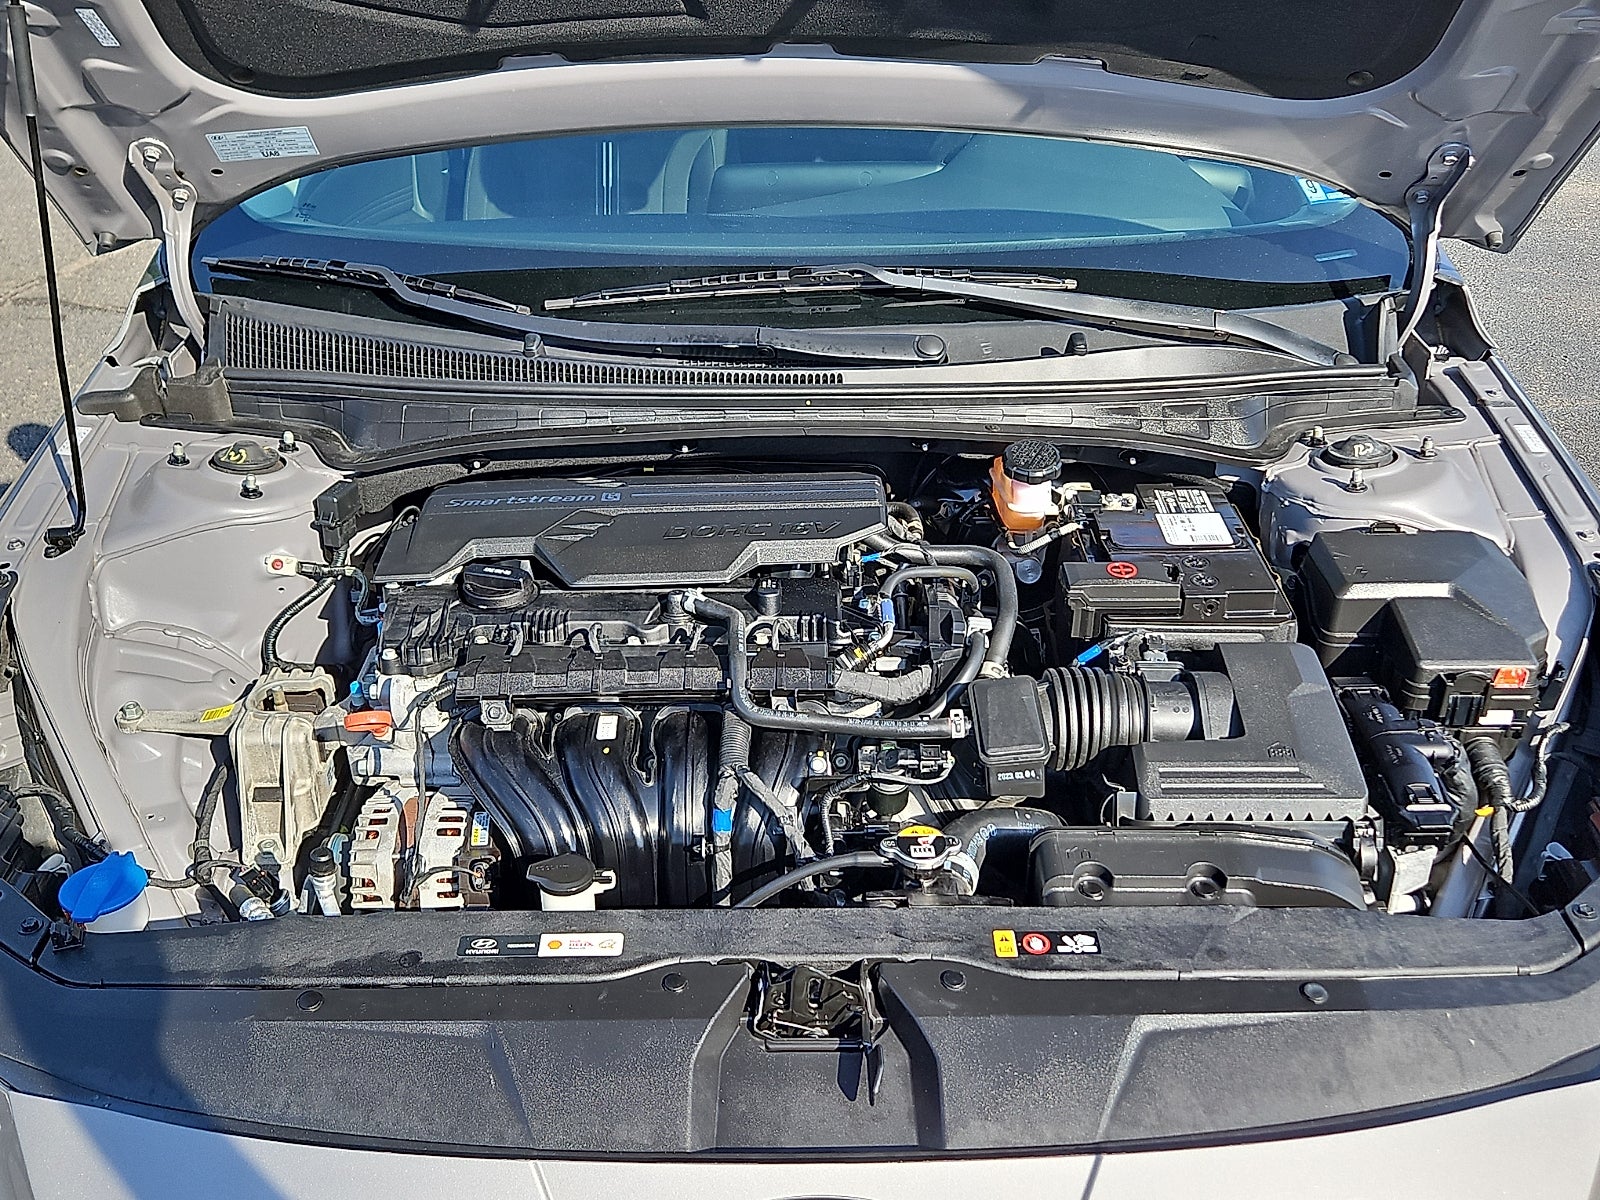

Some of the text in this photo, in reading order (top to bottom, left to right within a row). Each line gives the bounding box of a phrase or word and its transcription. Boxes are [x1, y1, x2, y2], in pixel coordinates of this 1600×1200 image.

[444, 493, 597, 509] Smartstream
[662, 520, 843, 541] DOHC 16V
[464, 947, 501, 955] HYUNDAI
